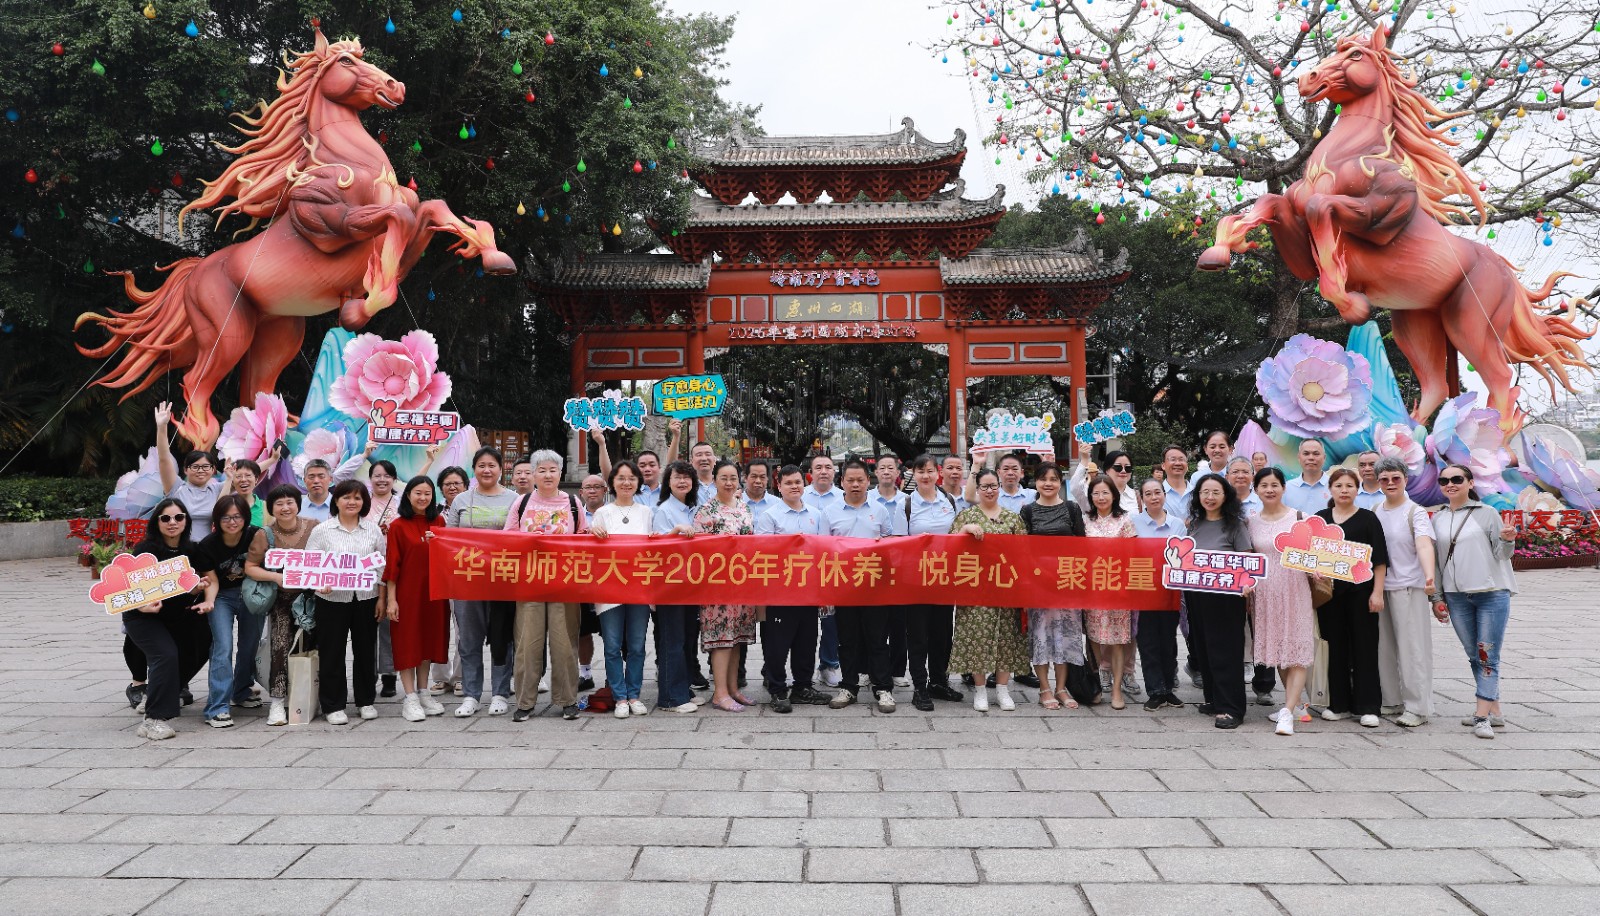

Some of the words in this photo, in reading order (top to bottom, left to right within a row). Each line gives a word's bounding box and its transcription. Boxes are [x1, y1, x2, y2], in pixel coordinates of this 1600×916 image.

[785, 299, 863, 319] 惠州西湖
[661, 378, 716, 395] 疗愈身心
[662, 395, 717, 412] 重启活力
[396, 413, 454, 427] 幸福华师
[565, 398, 646, 430] 赞赞赞
[989, 415, 1039, 429] 疗养身心
[373, 427, 432, 441] 健康疗养
[974, 431, 1050, 445] 共享美好时光
[1312, 538, 1367, 559] 华师我家
[267, 551, 357, 569] 疗养暖人心
[1193, 553, 1260, 570] 幸福华师
[1287, 550, 1350, 575] 幸福一家
[129, 559, 185, 584] 华师我家
[285, 570, 374, 588] 蓄力向前行
[1169, 569, 1234, 588] 健康疗养
[110, 579, 177, 609] 幸福一家
